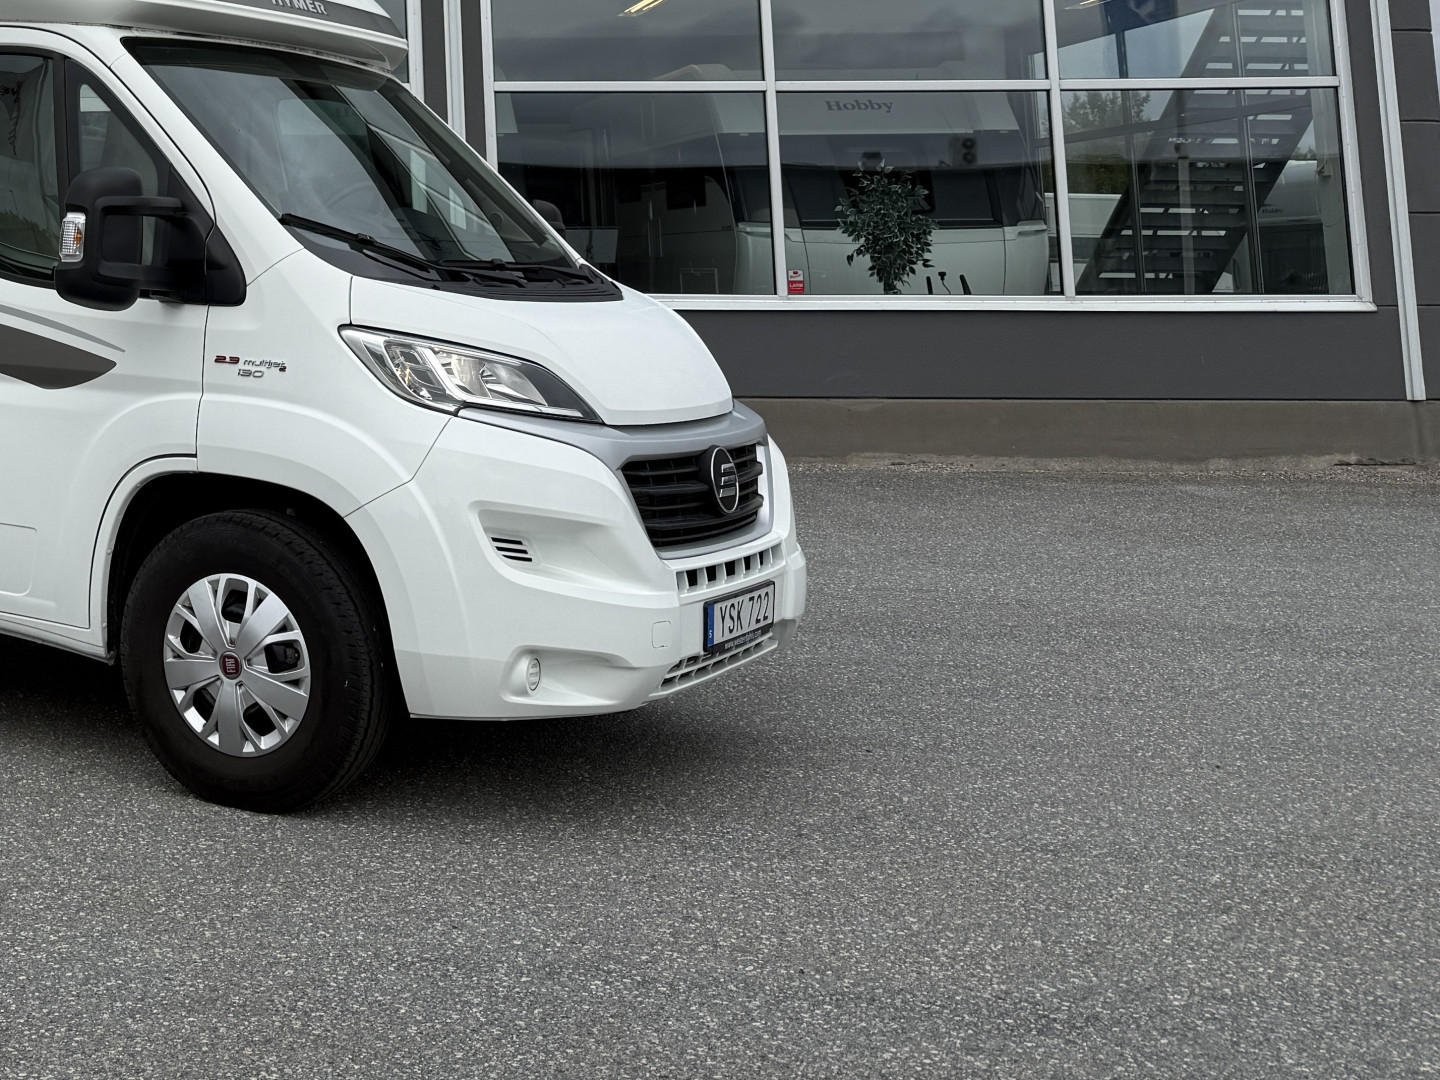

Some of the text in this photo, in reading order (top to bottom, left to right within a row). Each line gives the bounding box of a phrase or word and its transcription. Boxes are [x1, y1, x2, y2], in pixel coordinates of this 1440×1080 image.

[825, 99, 893, 113] Hobby
[237, 368, 264, 378] 130
[720, 591, 769, 638] YSK 722
[225, 657, 237, 673] FIAT
